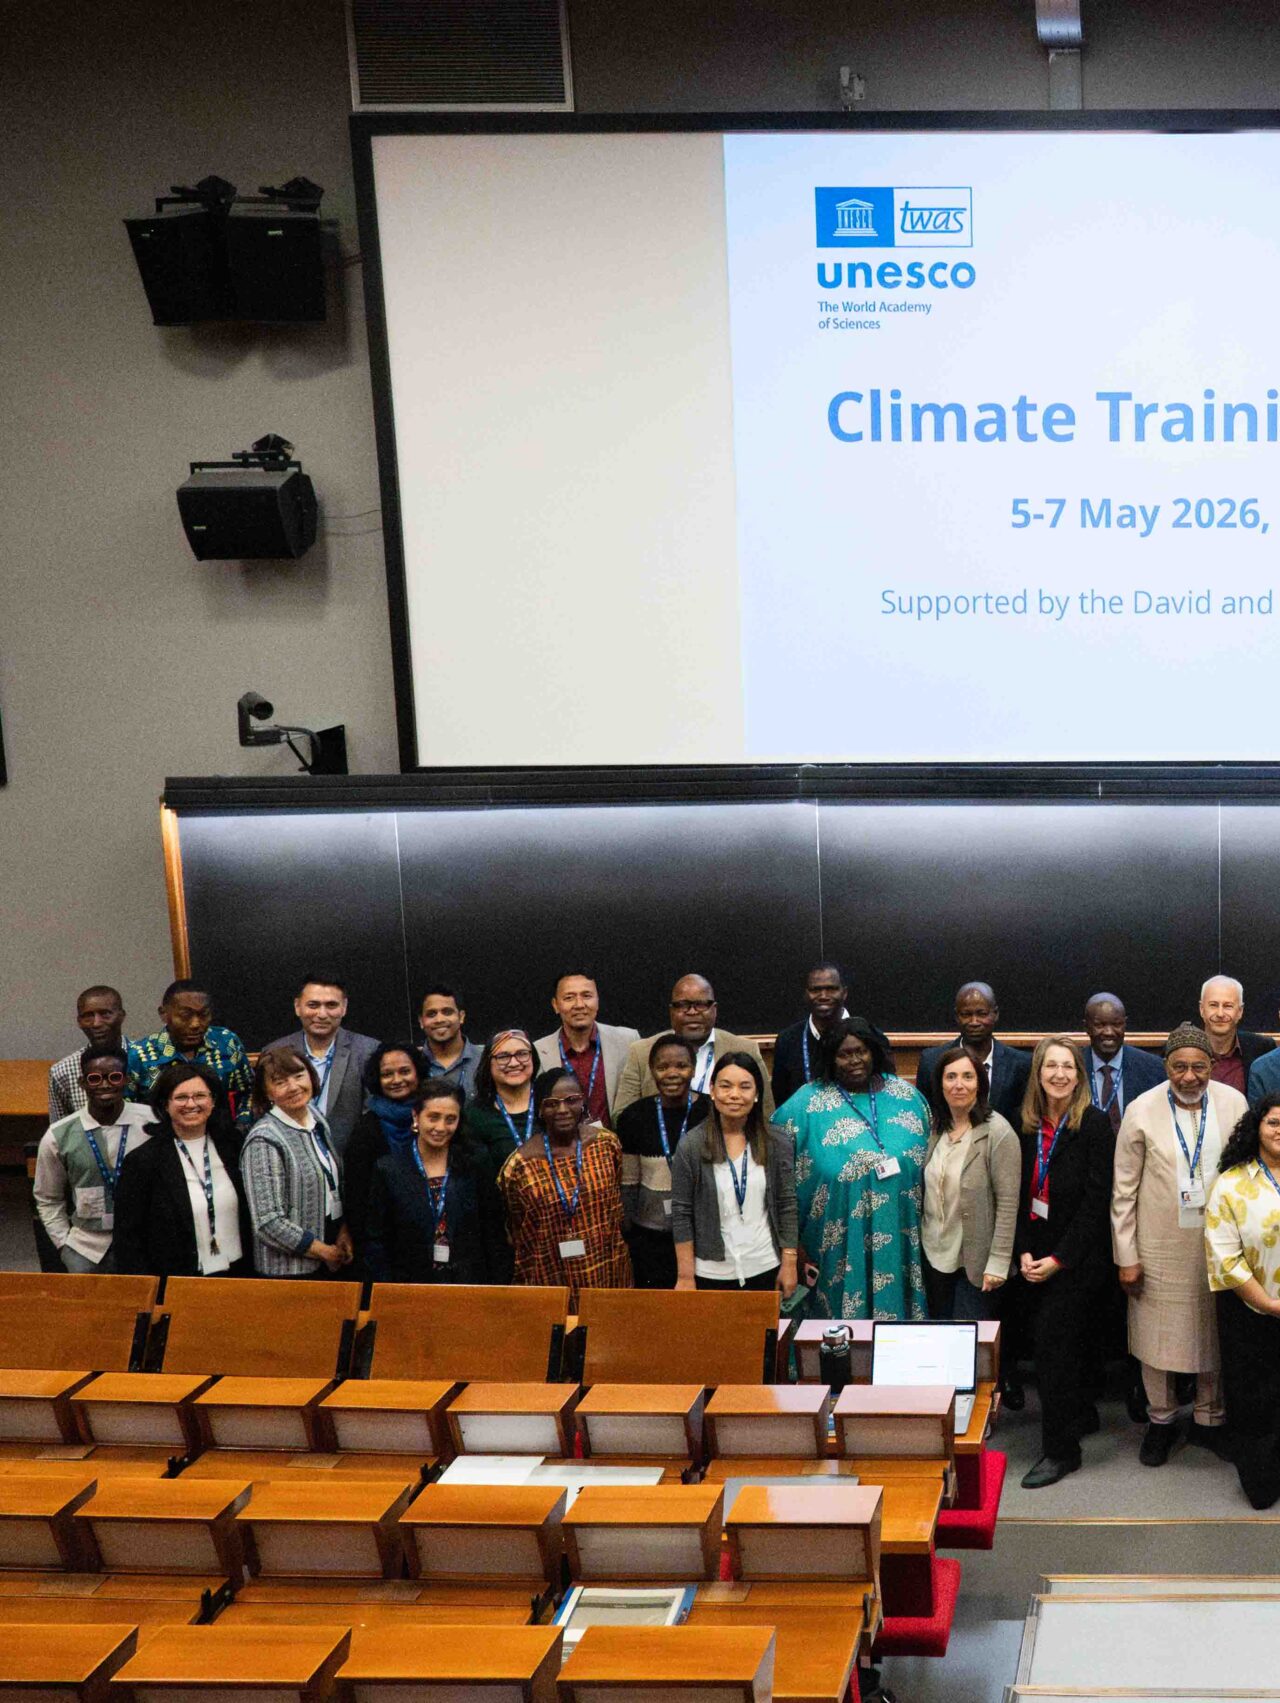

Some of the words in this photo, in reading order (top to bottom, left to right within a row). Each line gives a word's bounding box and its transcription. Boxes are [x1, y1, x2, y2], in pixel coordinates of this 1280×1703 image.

[900, 200, 967, 234] twas
[817, 261, 976, 289] unesco
[817, 301, 839, 312] The
[842, 301, 876, 312] World
[879, 301, 932, 315] Academy
[818, 317, 830, 329] of
[832, 317, 880, 329] Sciences
[827, 388, 1076, 443] Climate
[1011, 498, 1067, 529] 5-7
[1080, 498, 1161, 538] May
[1172, 498, 1269, 534] 2026,
[881, 588, 1028, 621] Supported
[1039, 588, 1071, 621] by
[1079, 589, 1124, 615] the
[1134, 589, 1211, 615] David
[1222, 589, 1273, 615] and
